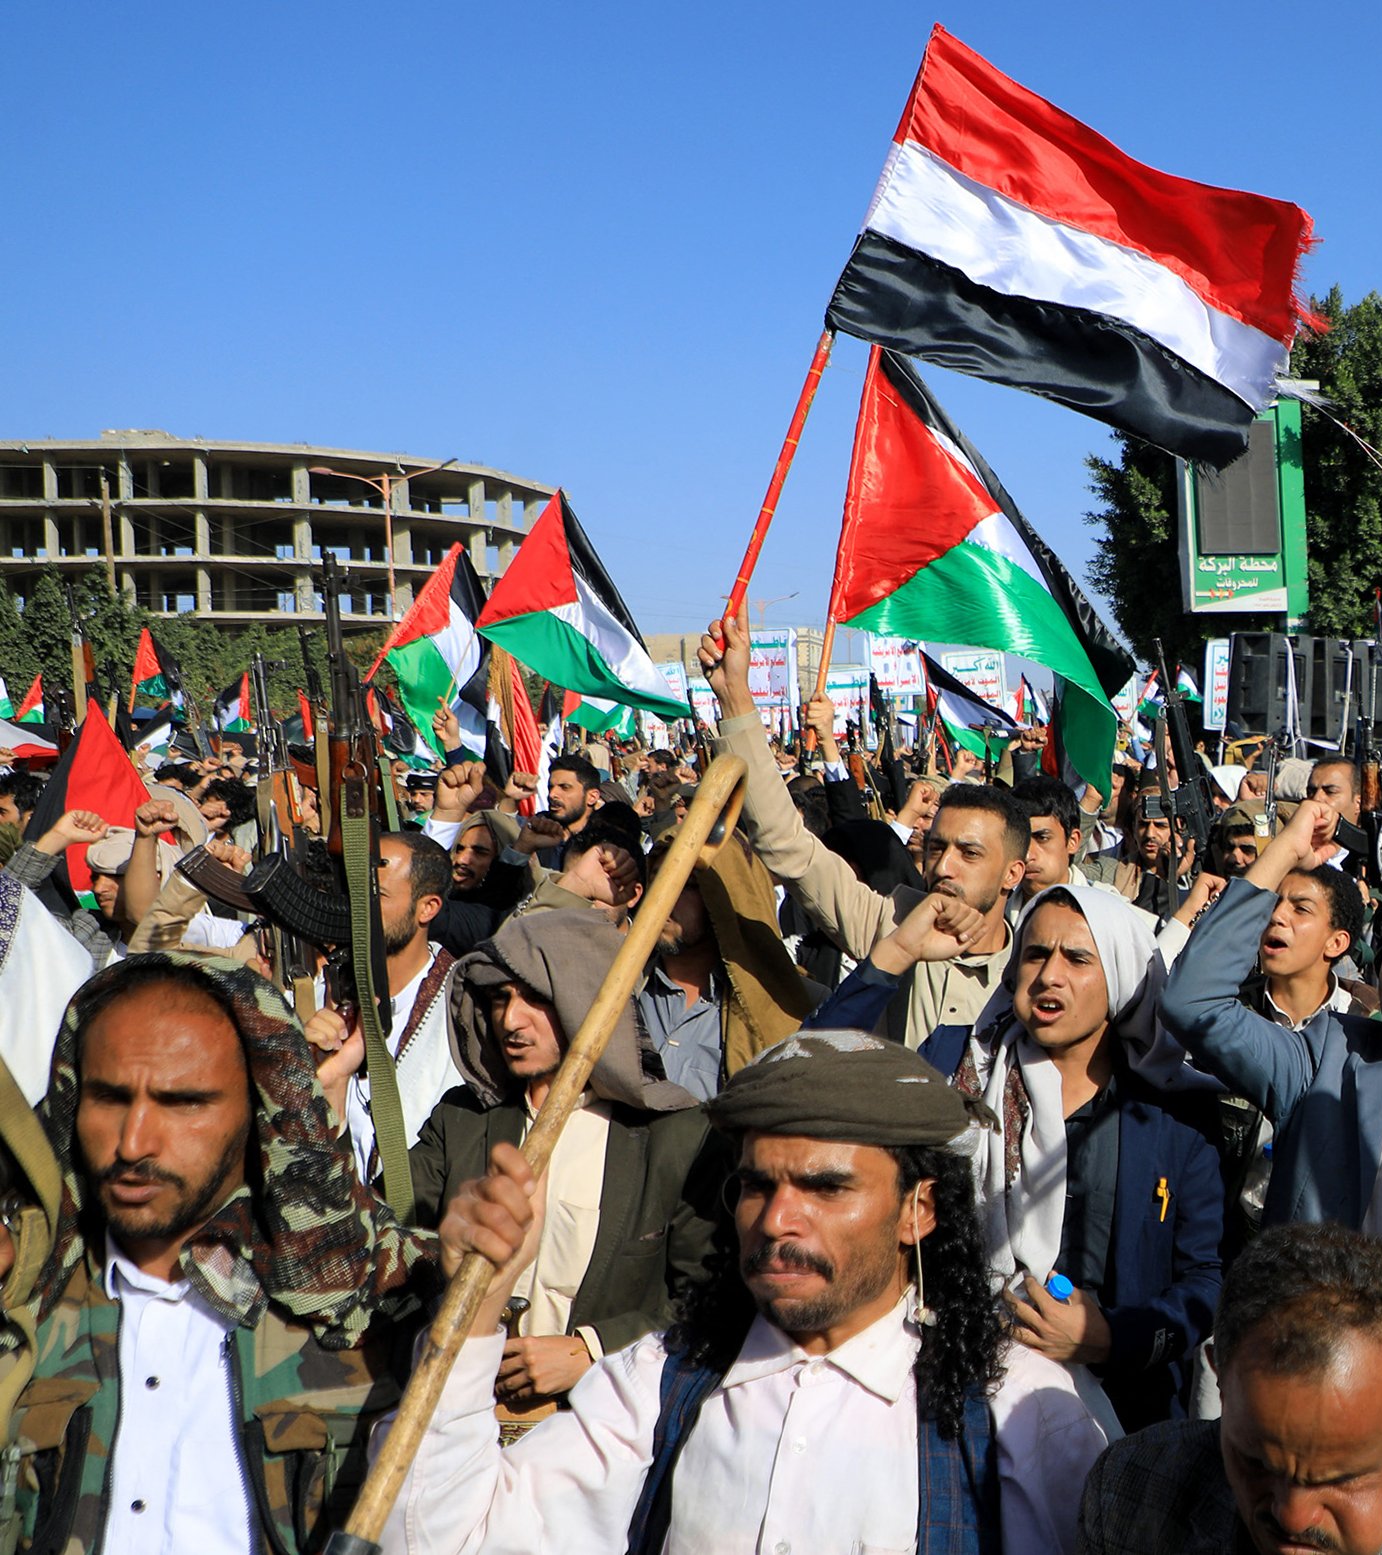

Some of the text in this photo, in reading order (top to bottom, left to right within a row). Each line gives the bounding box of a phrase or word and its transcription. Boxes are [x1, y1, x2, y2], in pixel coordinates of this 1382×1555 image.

[1198, 556, 1278, 576] محطة البركة
[1216, 577, 1258, 591] للمحروقات
[985, 658, 999, 670] الله
[978, 674, 1000, 687] الموت
